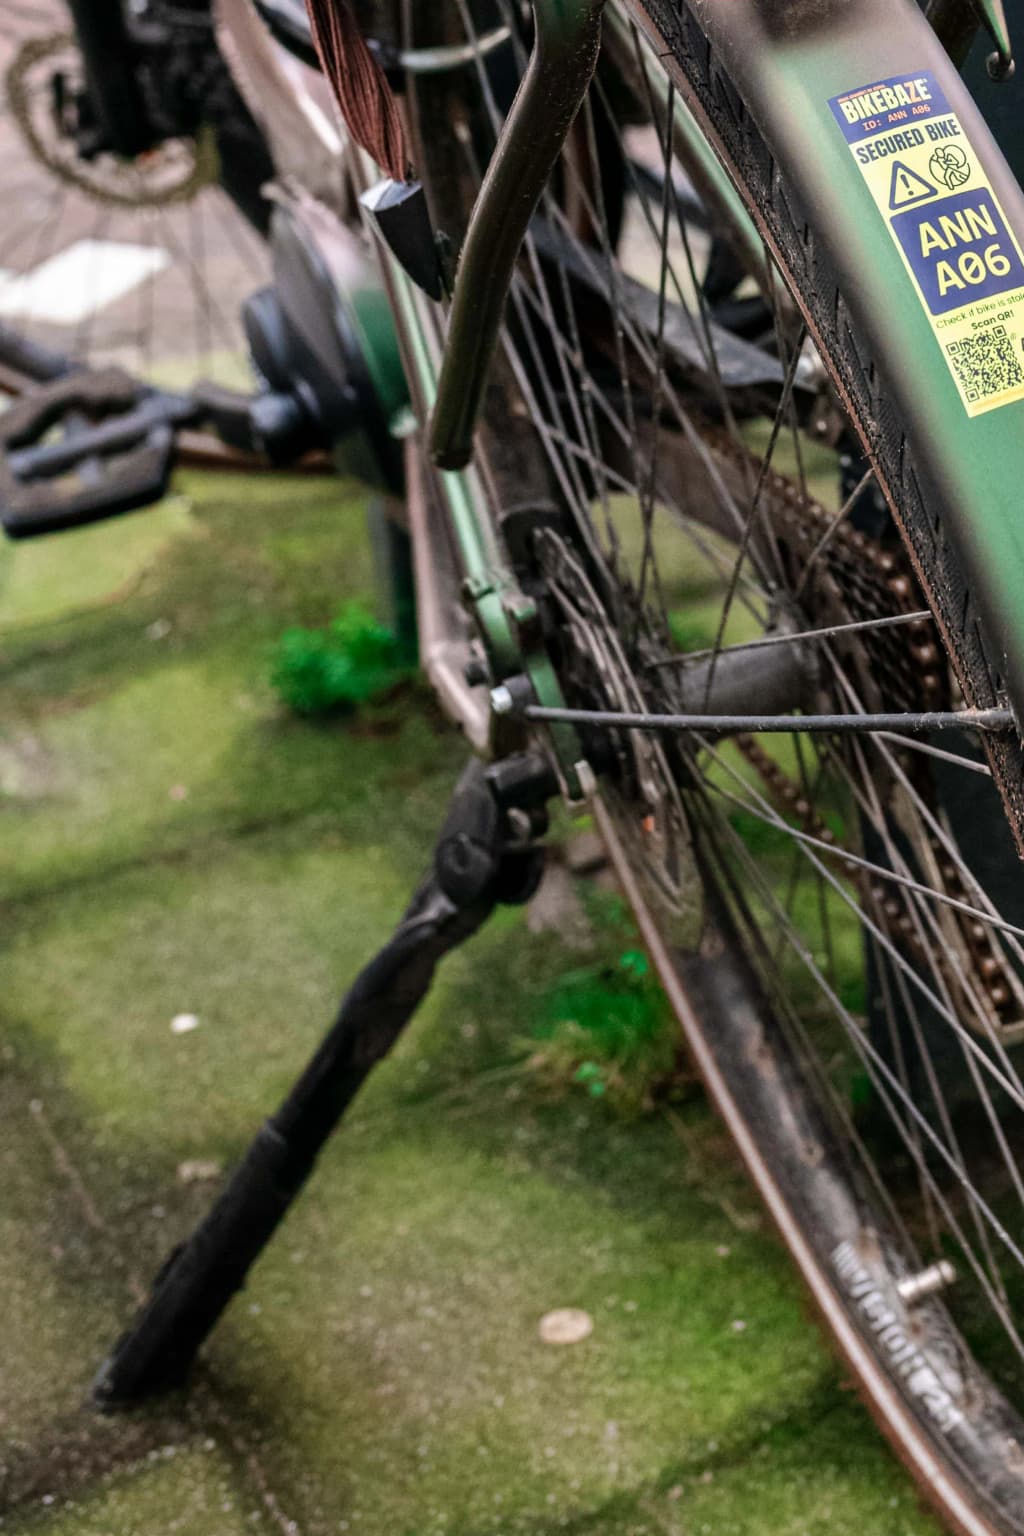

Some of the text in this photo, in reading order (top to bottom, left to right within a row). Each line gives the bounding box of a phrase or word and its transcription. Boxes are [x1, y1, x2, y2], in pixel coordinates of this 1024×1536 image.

[840, 78, 932, 124] BIKEBAZE
[862, 119, 882, 131] ID:
[887, 110, 908, 122] ANN
[856, 119, 961, 164] SECURED BIKE
[919, 204, 998, 258] ANN
[936, 244, 1011, 296] A06
[936, 312, 967, 329] Check
[976, 304, 997, 314] bike
[971, 309, 1015, 330] Scan QR!
